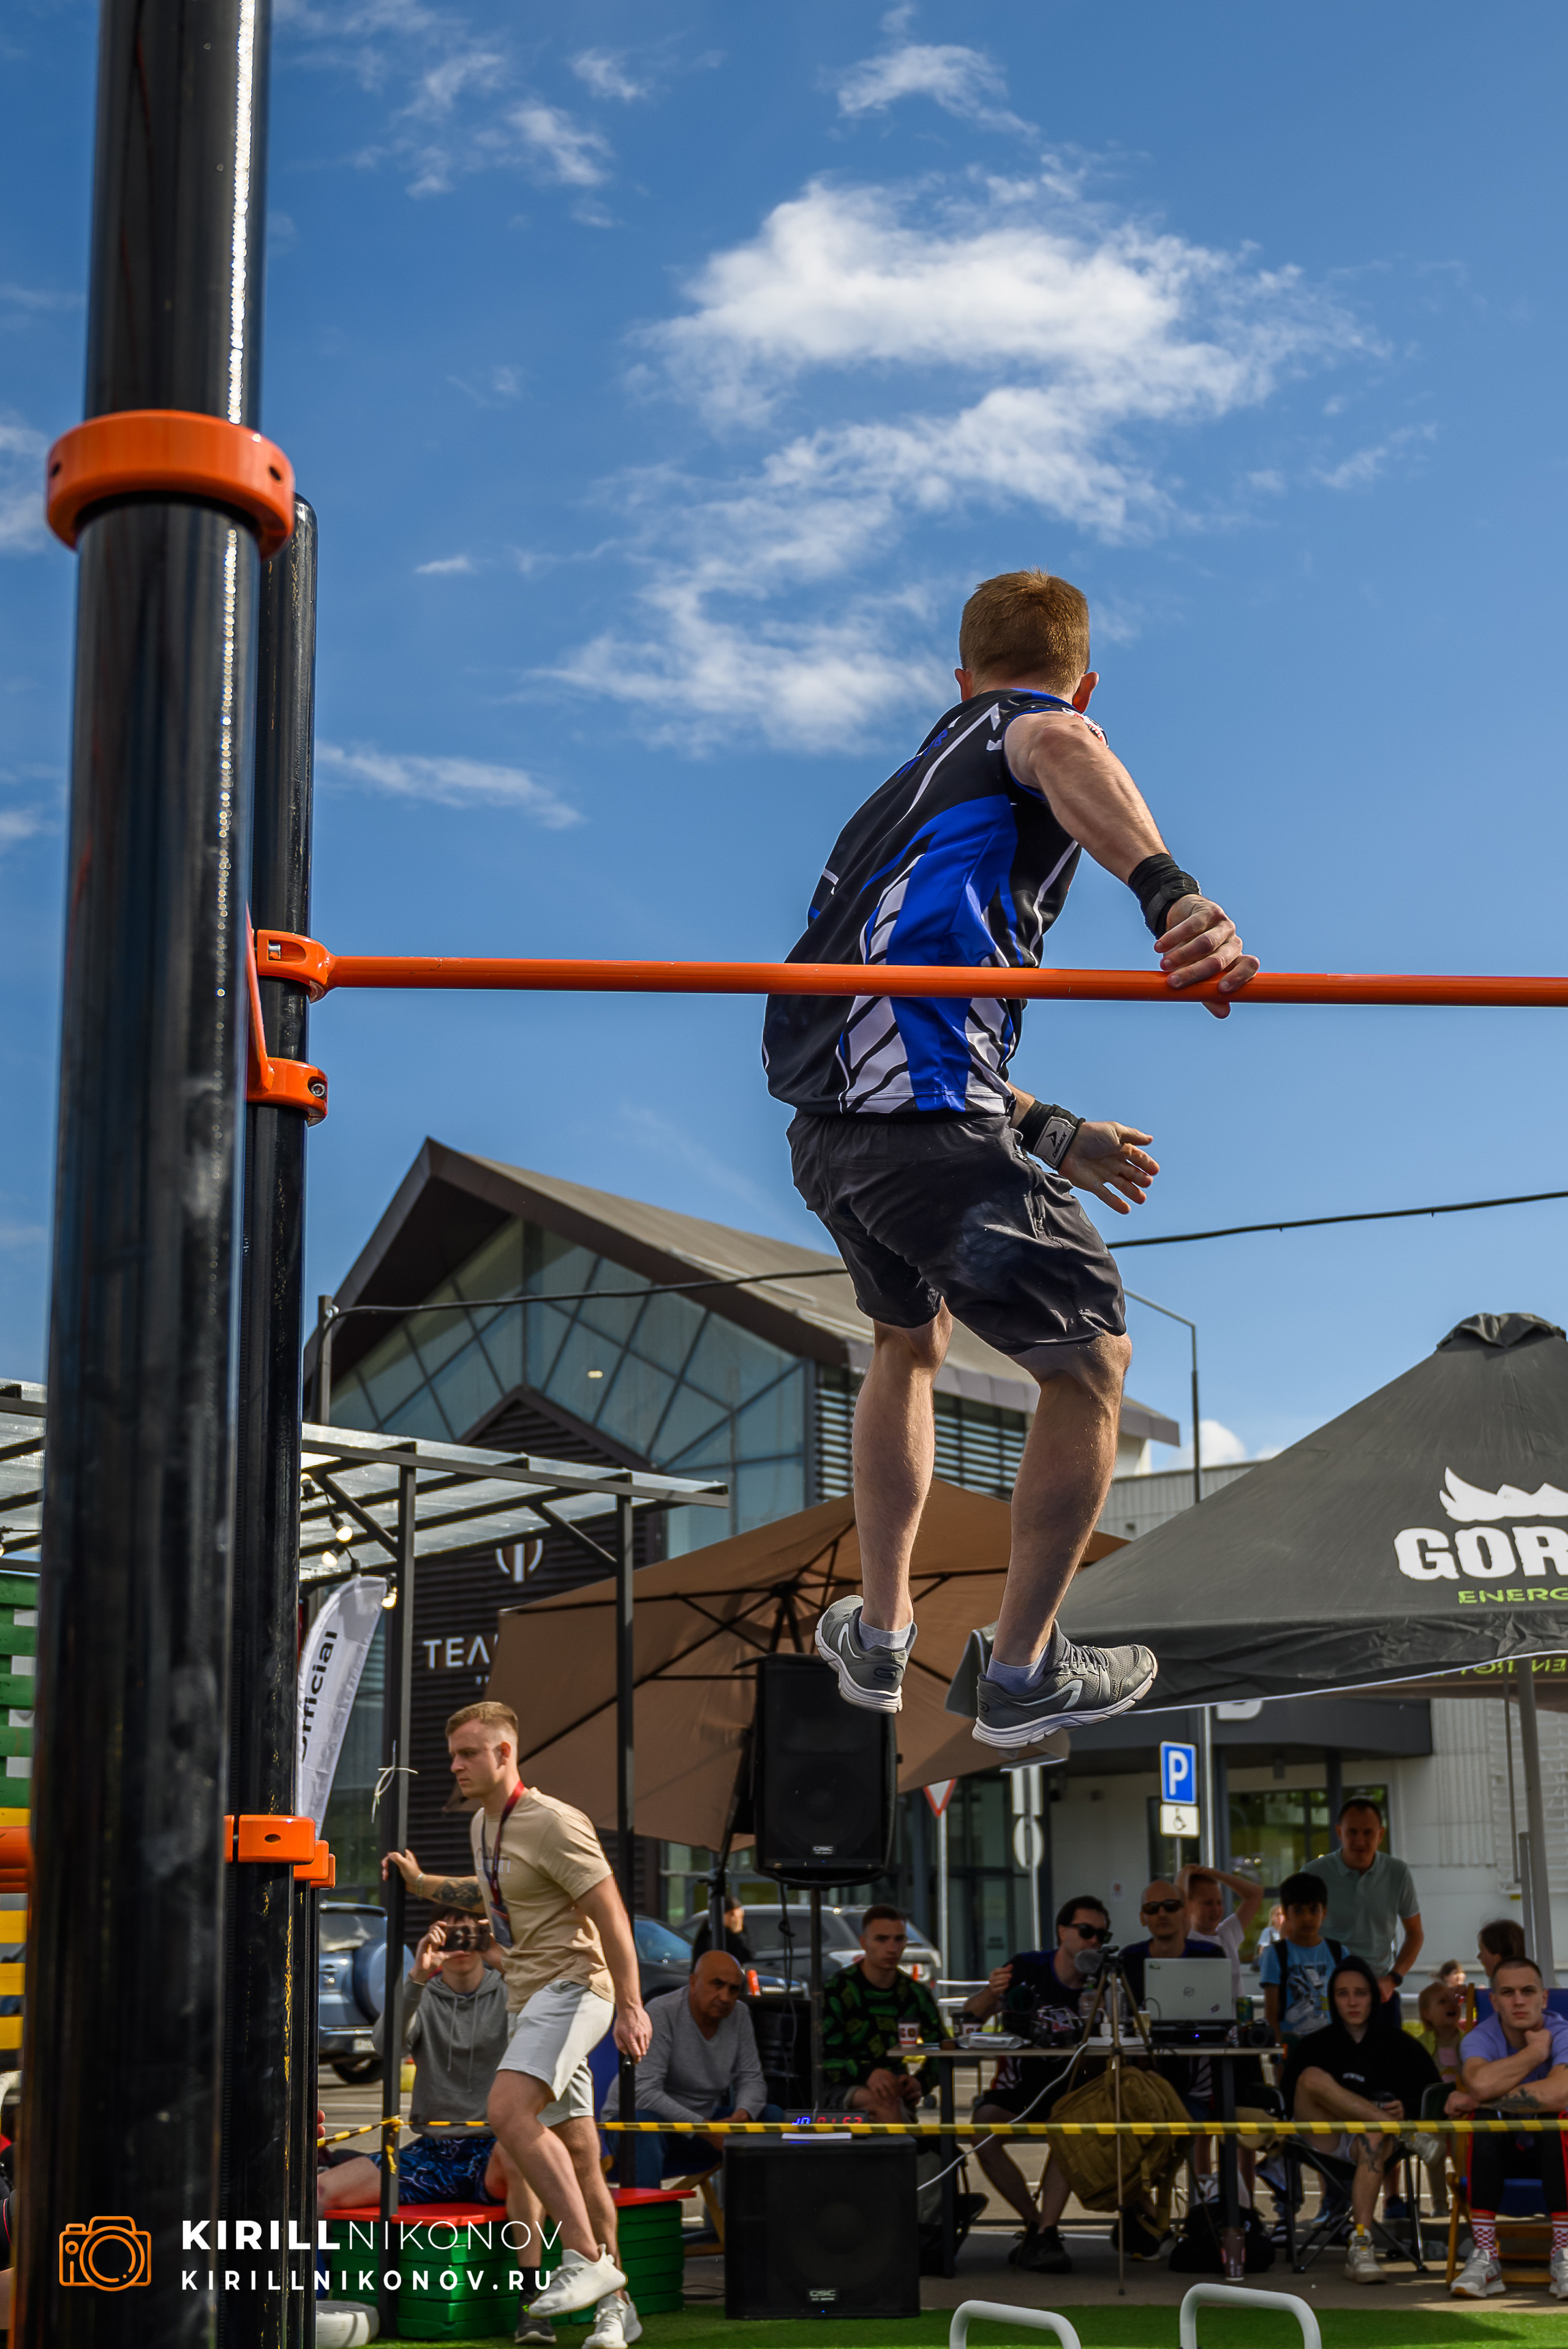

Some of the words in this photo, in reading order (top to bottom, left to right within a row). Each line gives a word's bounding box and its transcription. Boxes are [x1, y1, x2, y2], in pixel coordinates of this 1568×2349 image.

[1052, 1131, 1067, 1159] DEMIX
[302, 1631, 337, 1763] fficial
[1168, 1750, 1189, 1796] P
